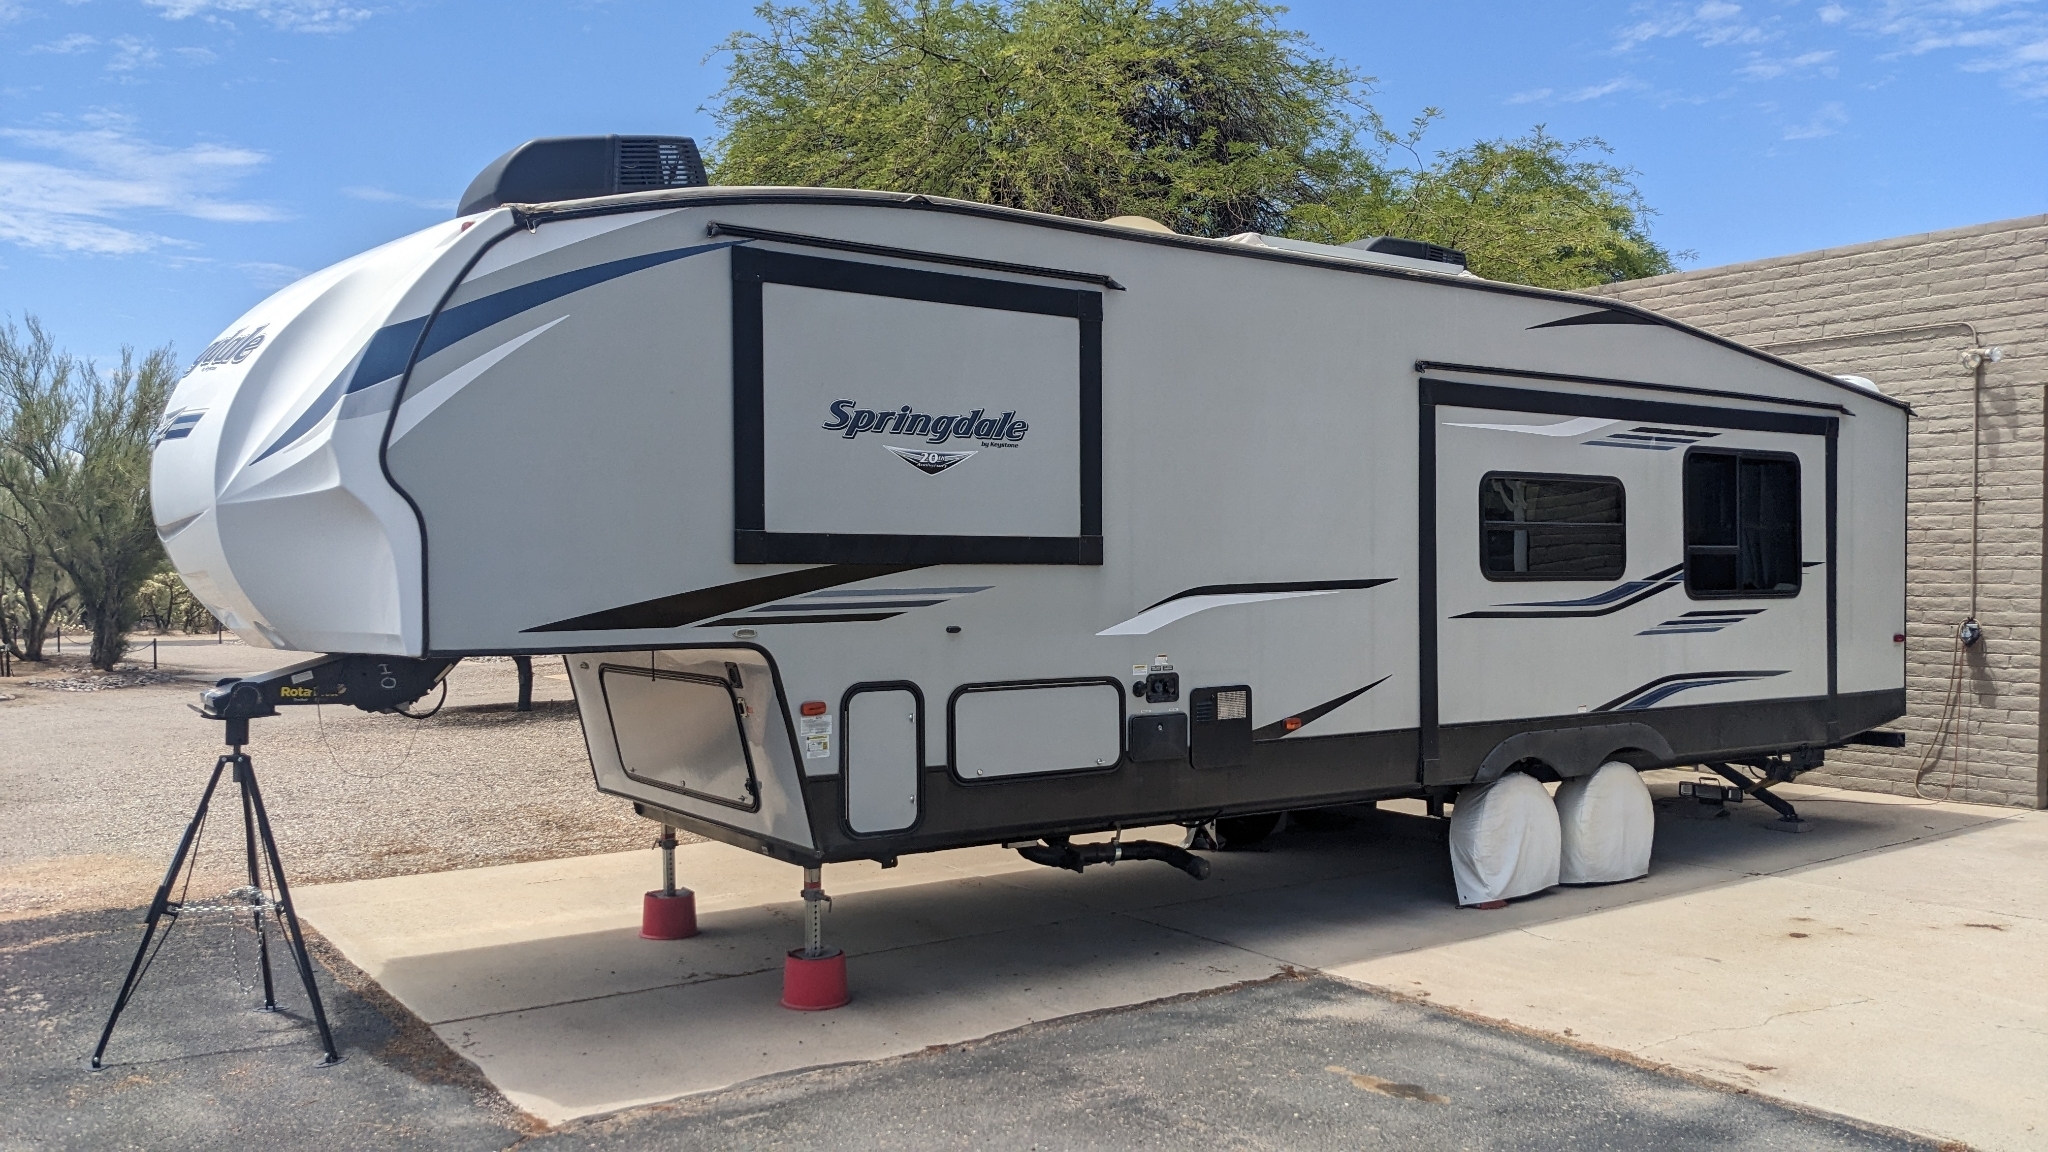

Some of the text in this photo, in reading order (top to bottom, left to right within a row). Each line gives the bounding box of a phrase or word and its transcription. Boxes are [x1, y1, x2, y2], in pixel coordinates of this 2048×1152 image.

[822, 399, 1028, 445] Springdale
[990, 441, 1019, 449] Keystone
[280, 686, 313, 697] Rota
